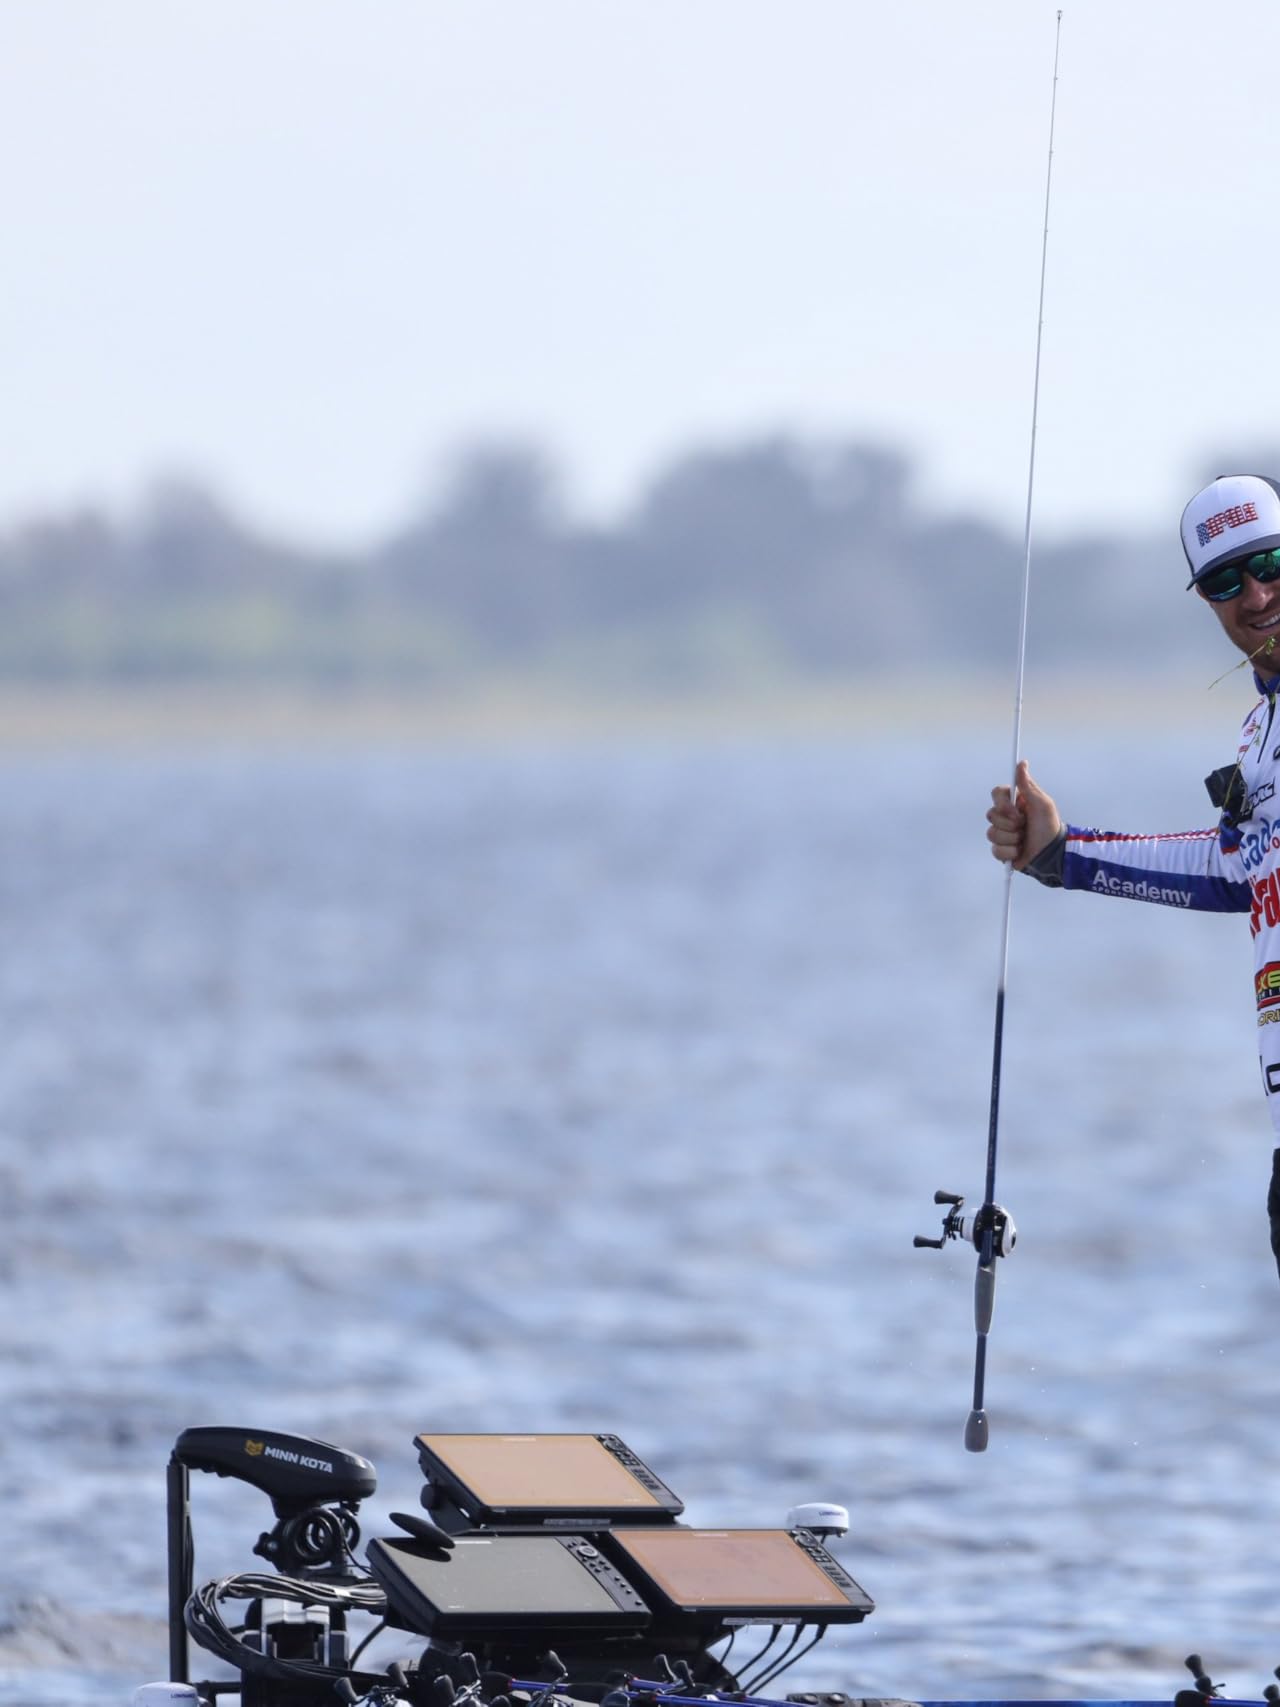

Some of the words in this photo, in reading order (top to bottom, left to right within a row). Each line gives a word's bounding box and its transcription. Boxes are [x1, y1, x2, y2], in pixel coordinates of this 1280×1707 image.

[1092, 869, 1192, 907] Academy
[264, 1446, 300, 1464] MINN
[299, 1455, 334, 1473] KOTA
